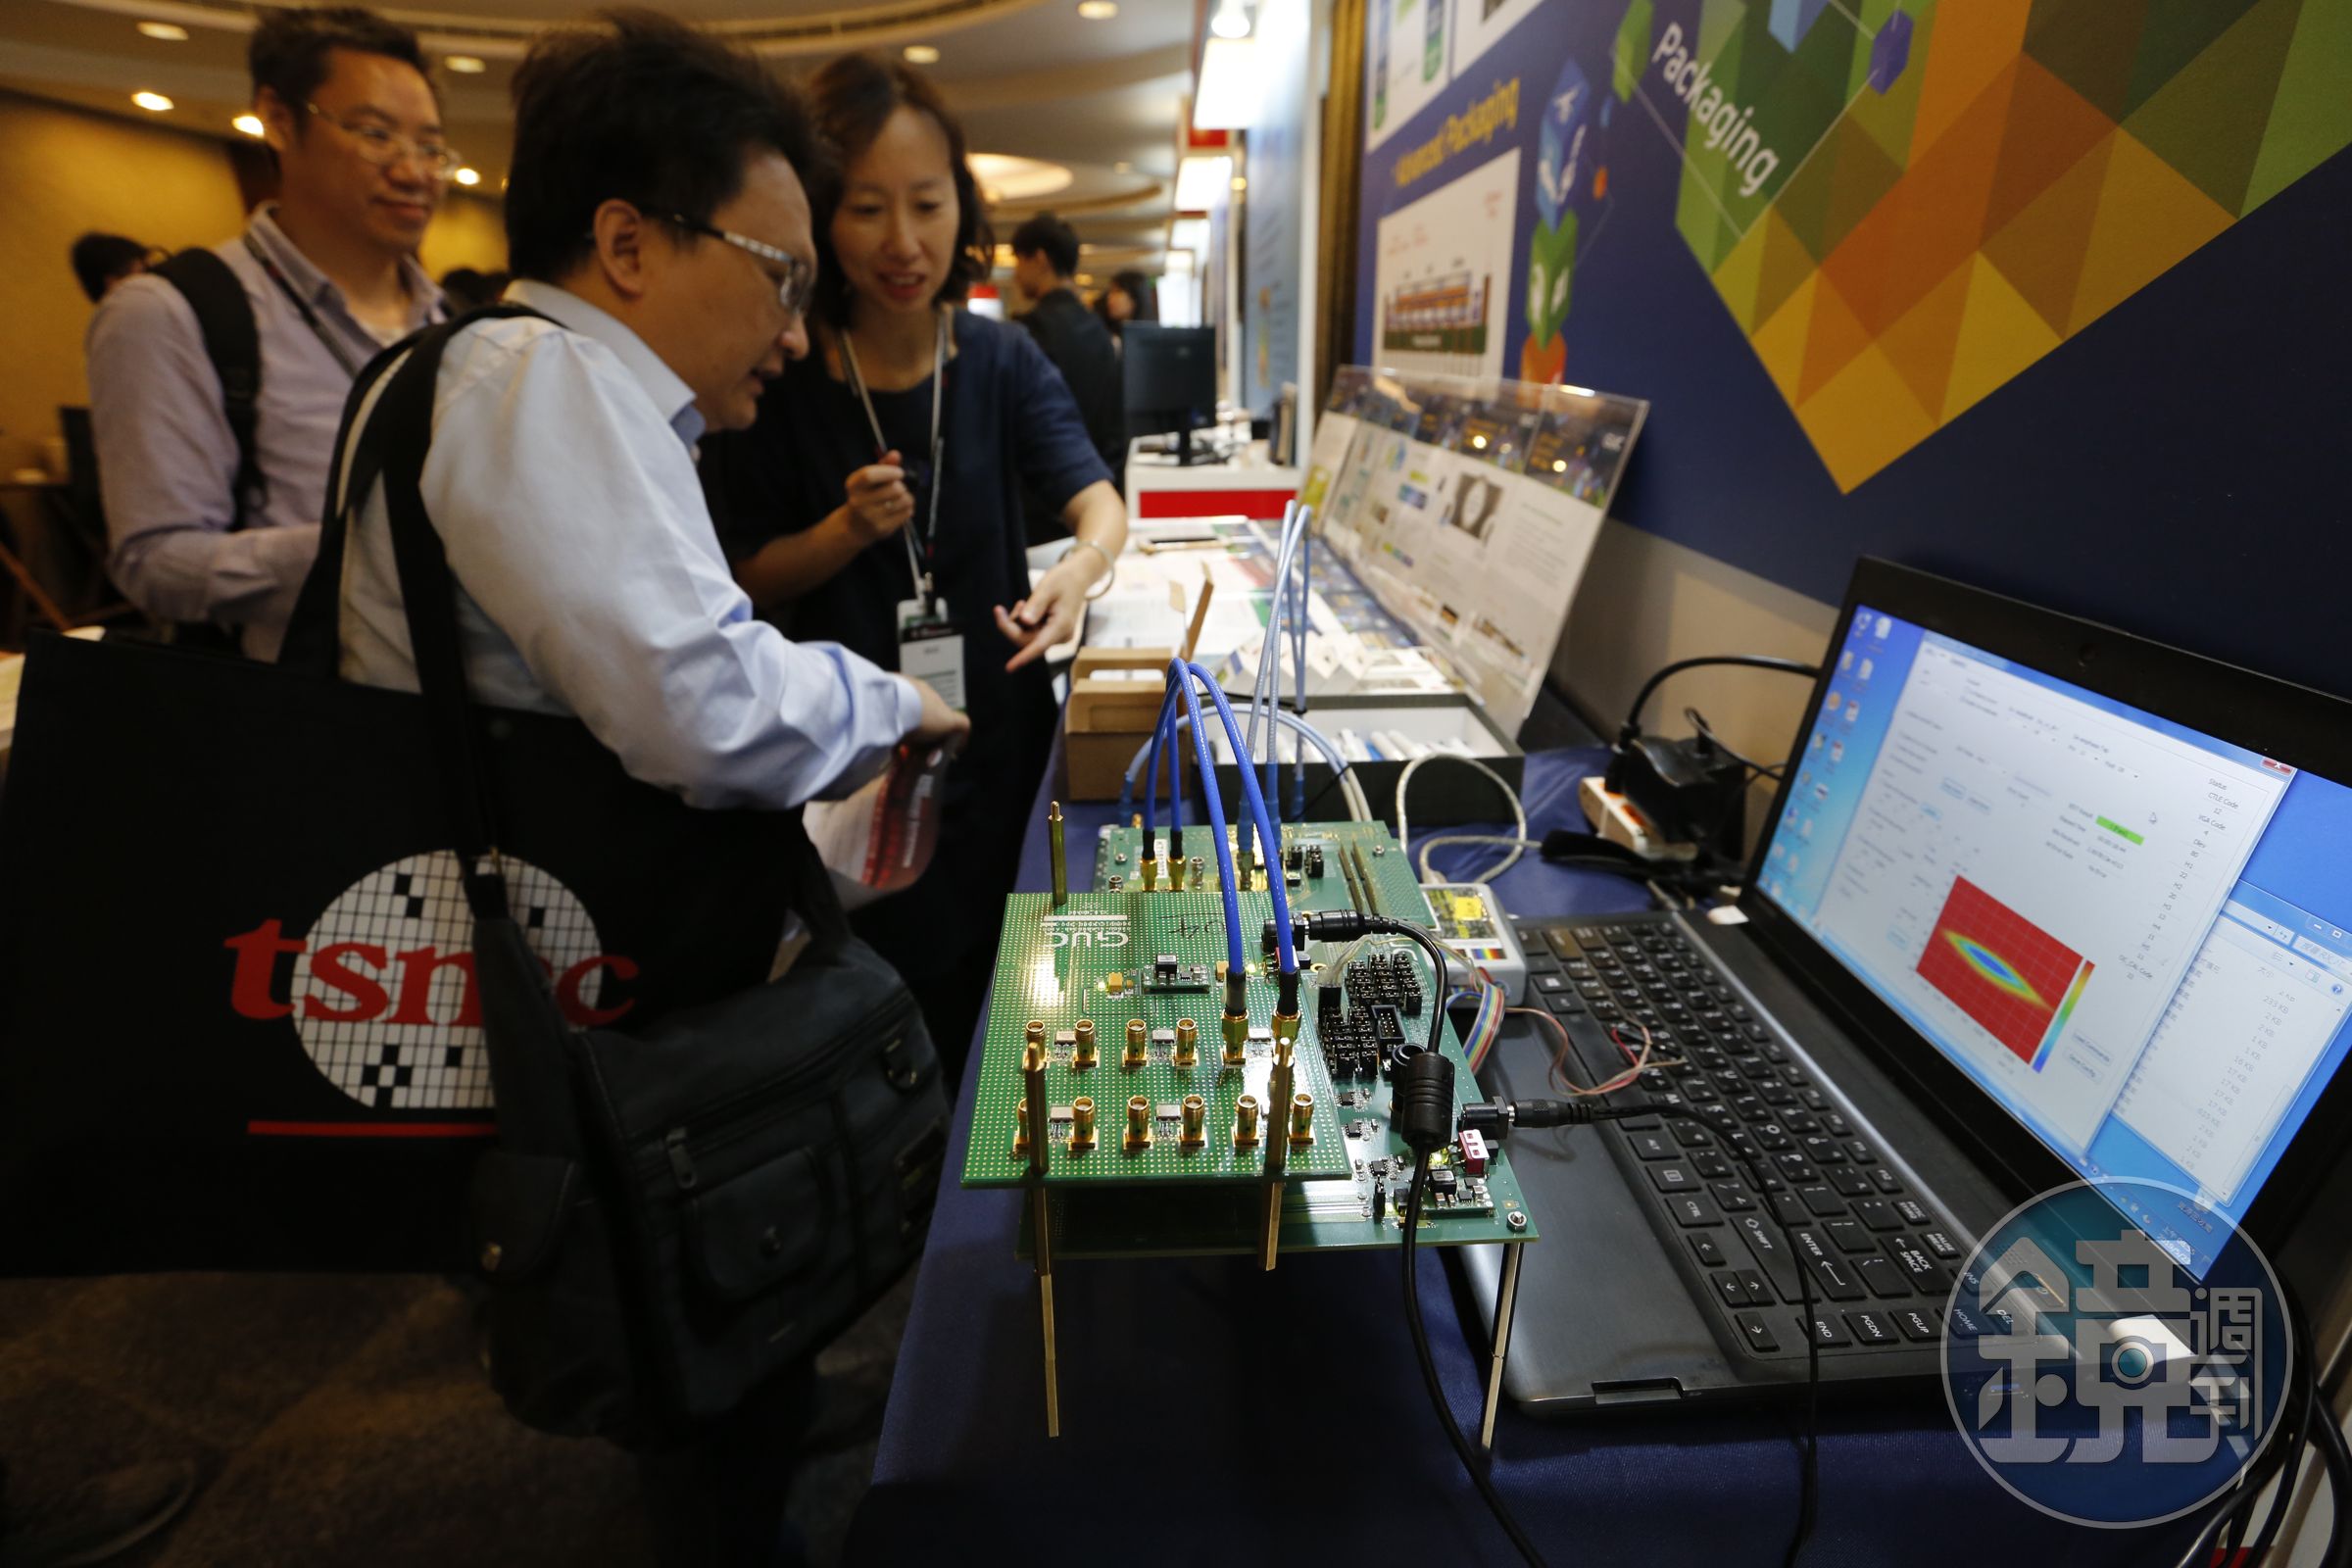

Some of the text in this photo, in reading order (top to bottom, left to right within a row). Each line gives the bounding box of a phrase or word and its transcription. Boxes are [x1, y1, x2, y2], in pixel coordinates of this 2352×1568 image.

[1651, 22, 1780, 197] Packaging
[1687, 1200, 1701, 1218] CTRL
[1753, 1230, 1773, 1250] SHIFT
[1800, 1233, 1823, 1257] ENTER
[1934, 1233, 1956, 1252] PAUSE
[1899, 1251, 1924, 1274] SPACE
[1910, 1250, 1933, 1271] BACK
[1963, 1272, 1980, 1286] INS
[1861, 1315, 1884, 1338] PGDN
[1908, 1312, 1930, 1334] PGUP
[1953, 1308, 1979, 1332] HOME
[1996, 1309, 2014, 1325] DEL
[1816, 1321, 1833, 1339] END
